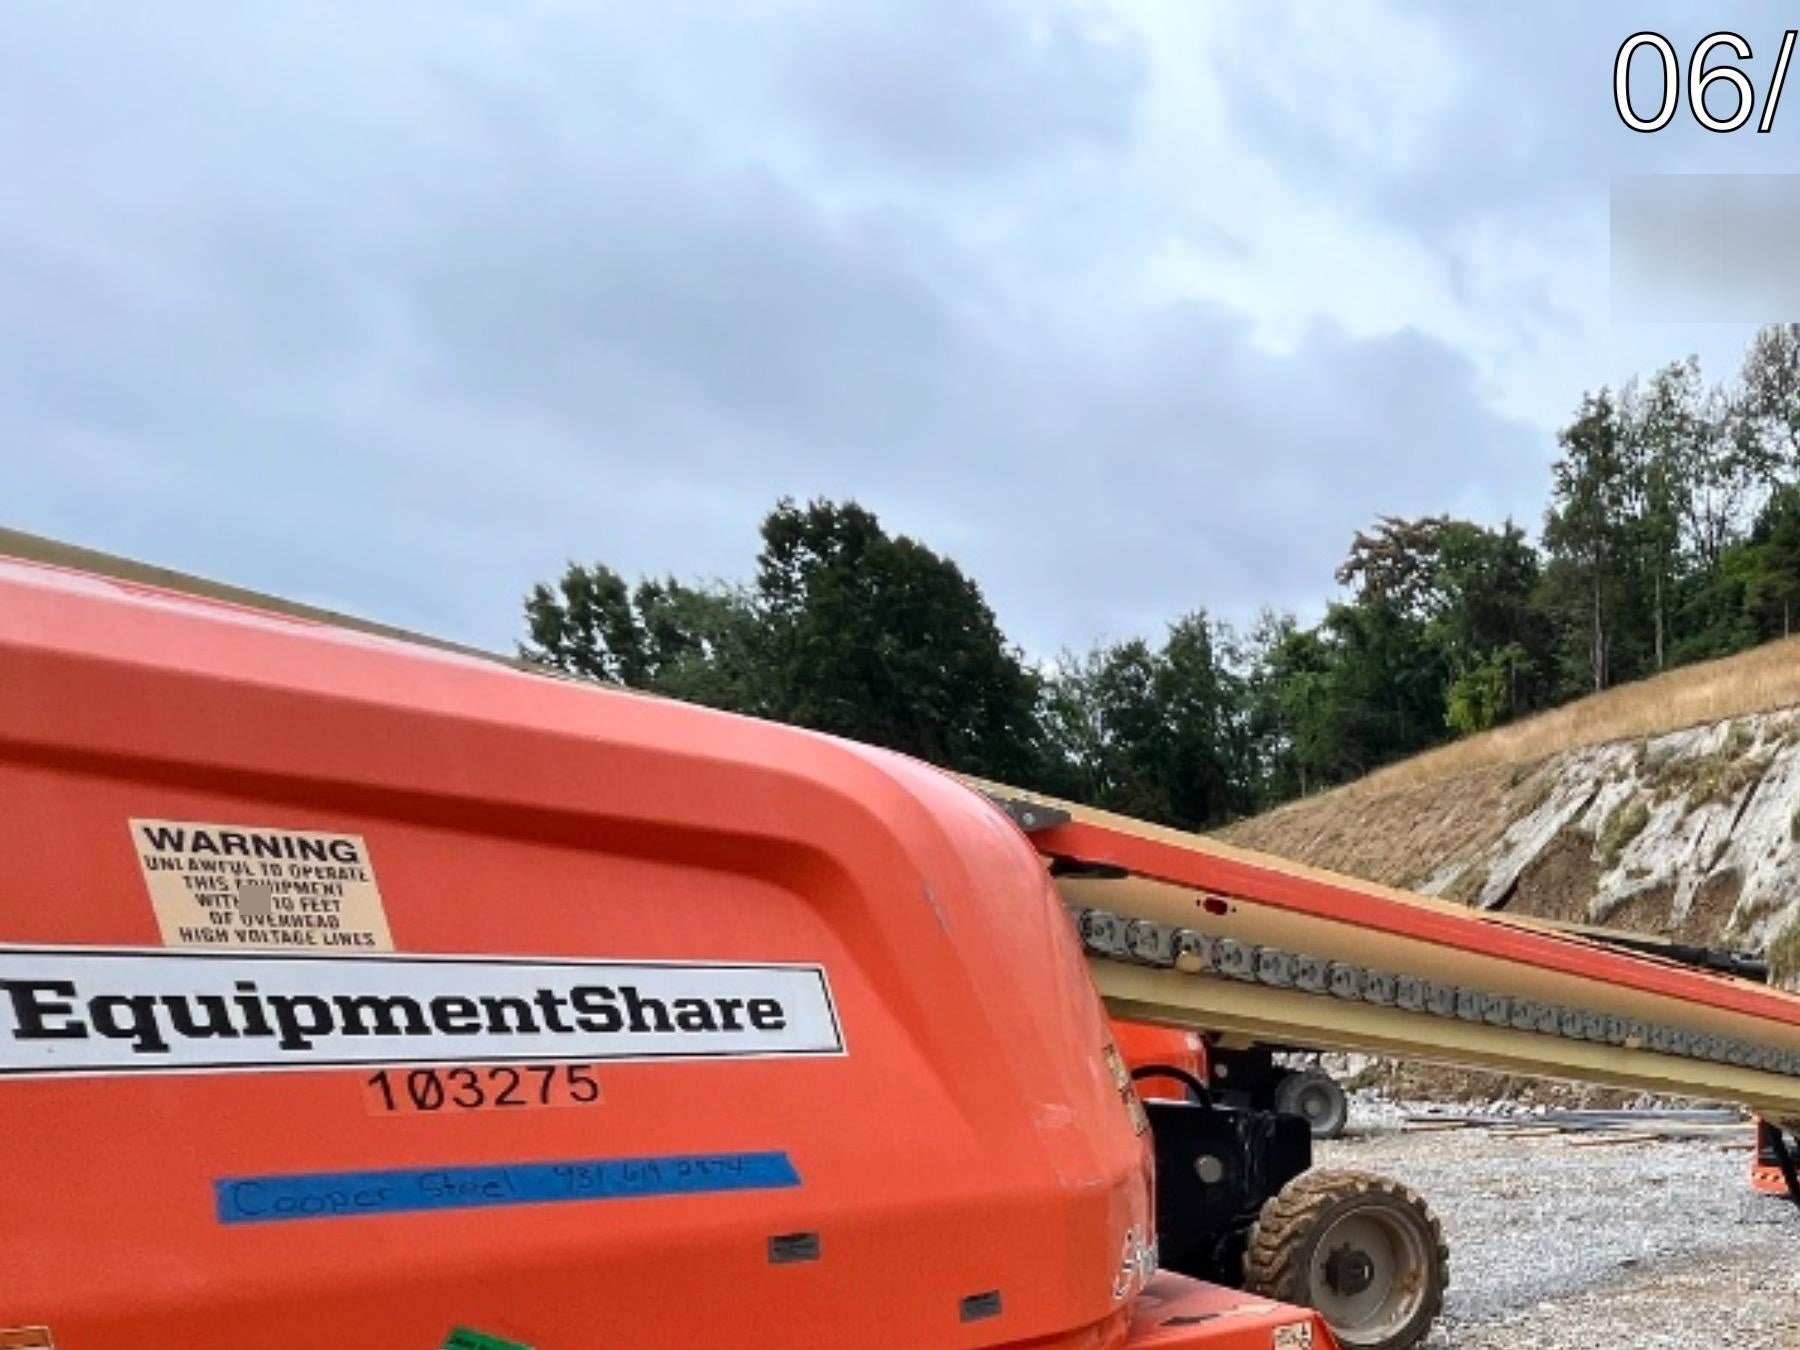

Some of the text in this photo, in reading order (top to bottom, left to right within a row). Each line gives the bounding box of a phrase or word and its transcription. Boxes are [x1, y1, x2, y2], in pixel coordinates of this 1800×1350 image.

[143, 827, 359, 864] WARNING
[144, 855, 370, 882] UNLAWFUL TO OPERATE
[183, 875, 230, 891] THIS
[272, 896, 295, 911] 10
[300, 897, 340, 913] FEET
[209, 911, 340, 930] OF OVERHEAD
[179, 927, 376, 946] HIGH VOLTAGE LINES
[2, 978, 787, 1053] EquipmentShare
[368, 1064, 600, 1111] 103275
[232, 1181, 394, 1216] Cooper
